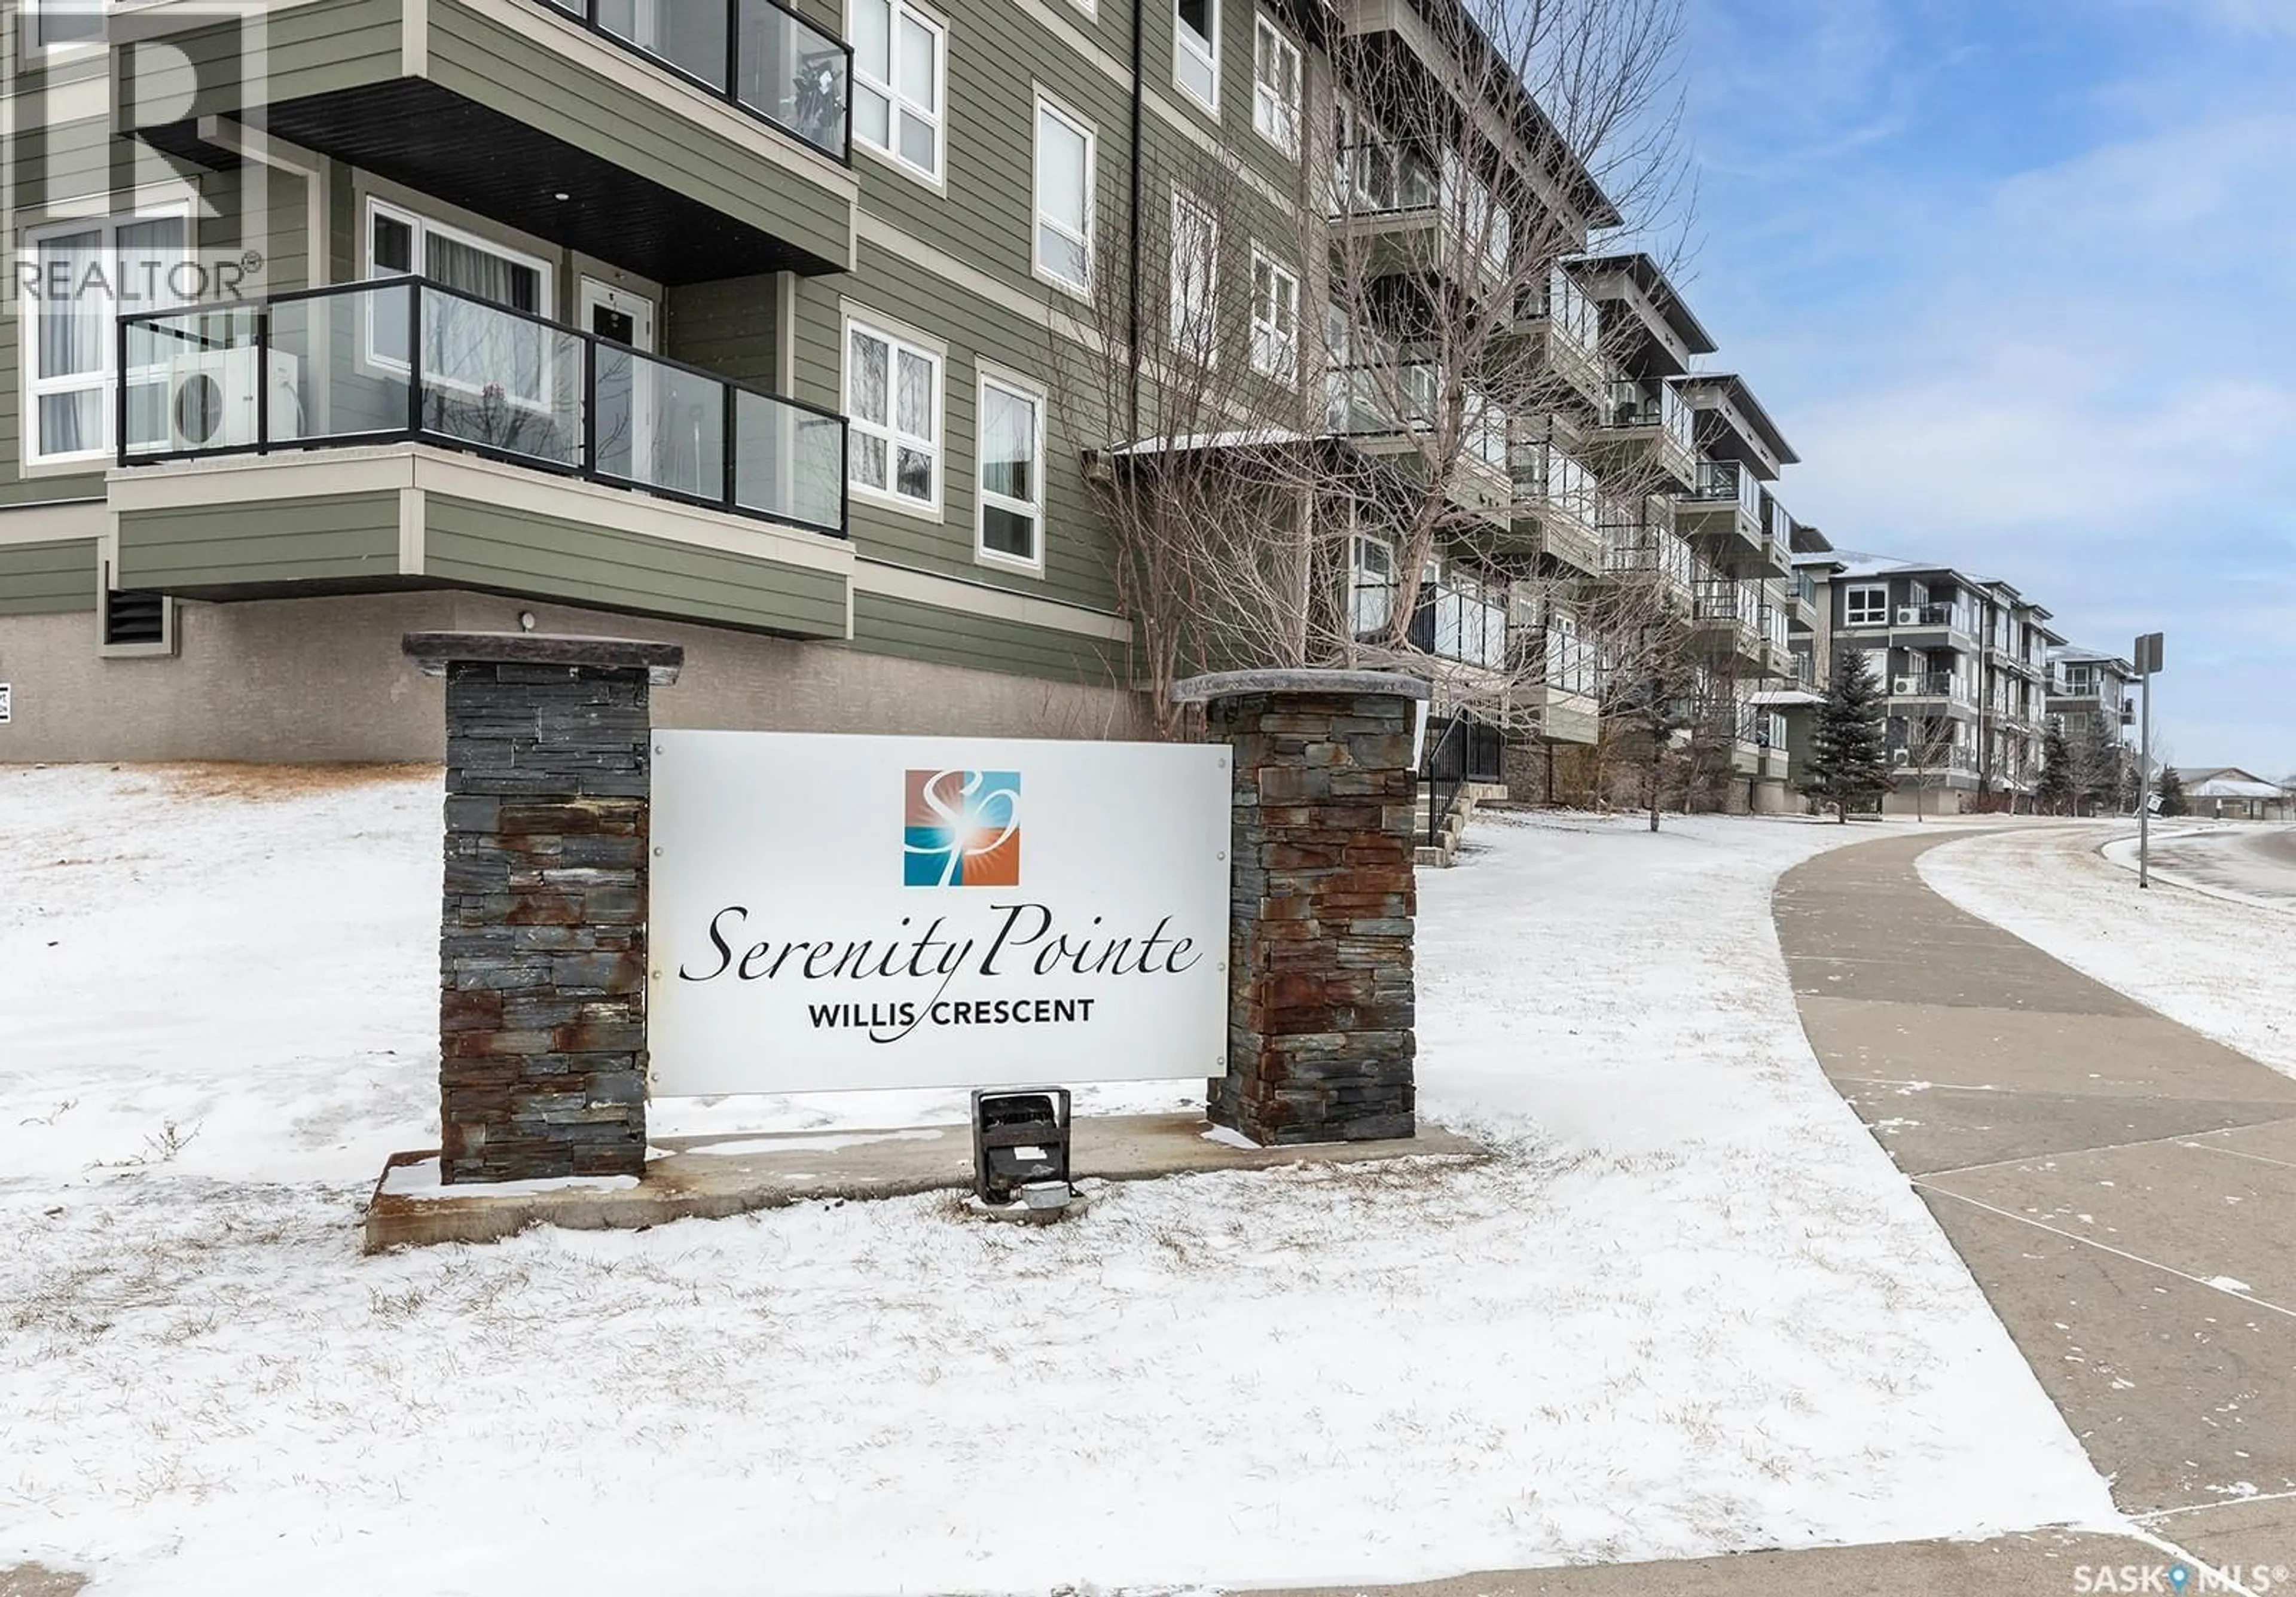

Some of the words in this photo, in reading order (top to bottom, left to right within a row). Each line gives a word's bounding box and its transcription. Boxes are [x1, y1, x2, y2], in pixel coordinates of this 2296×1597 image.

[679, 906, 973, 1043] Serenity
[979, 904, 1204, 977] Pointe
[808, 1002, 915, 1028] WILLIS
[931, 998, 1095, 1025] CRESCENT
